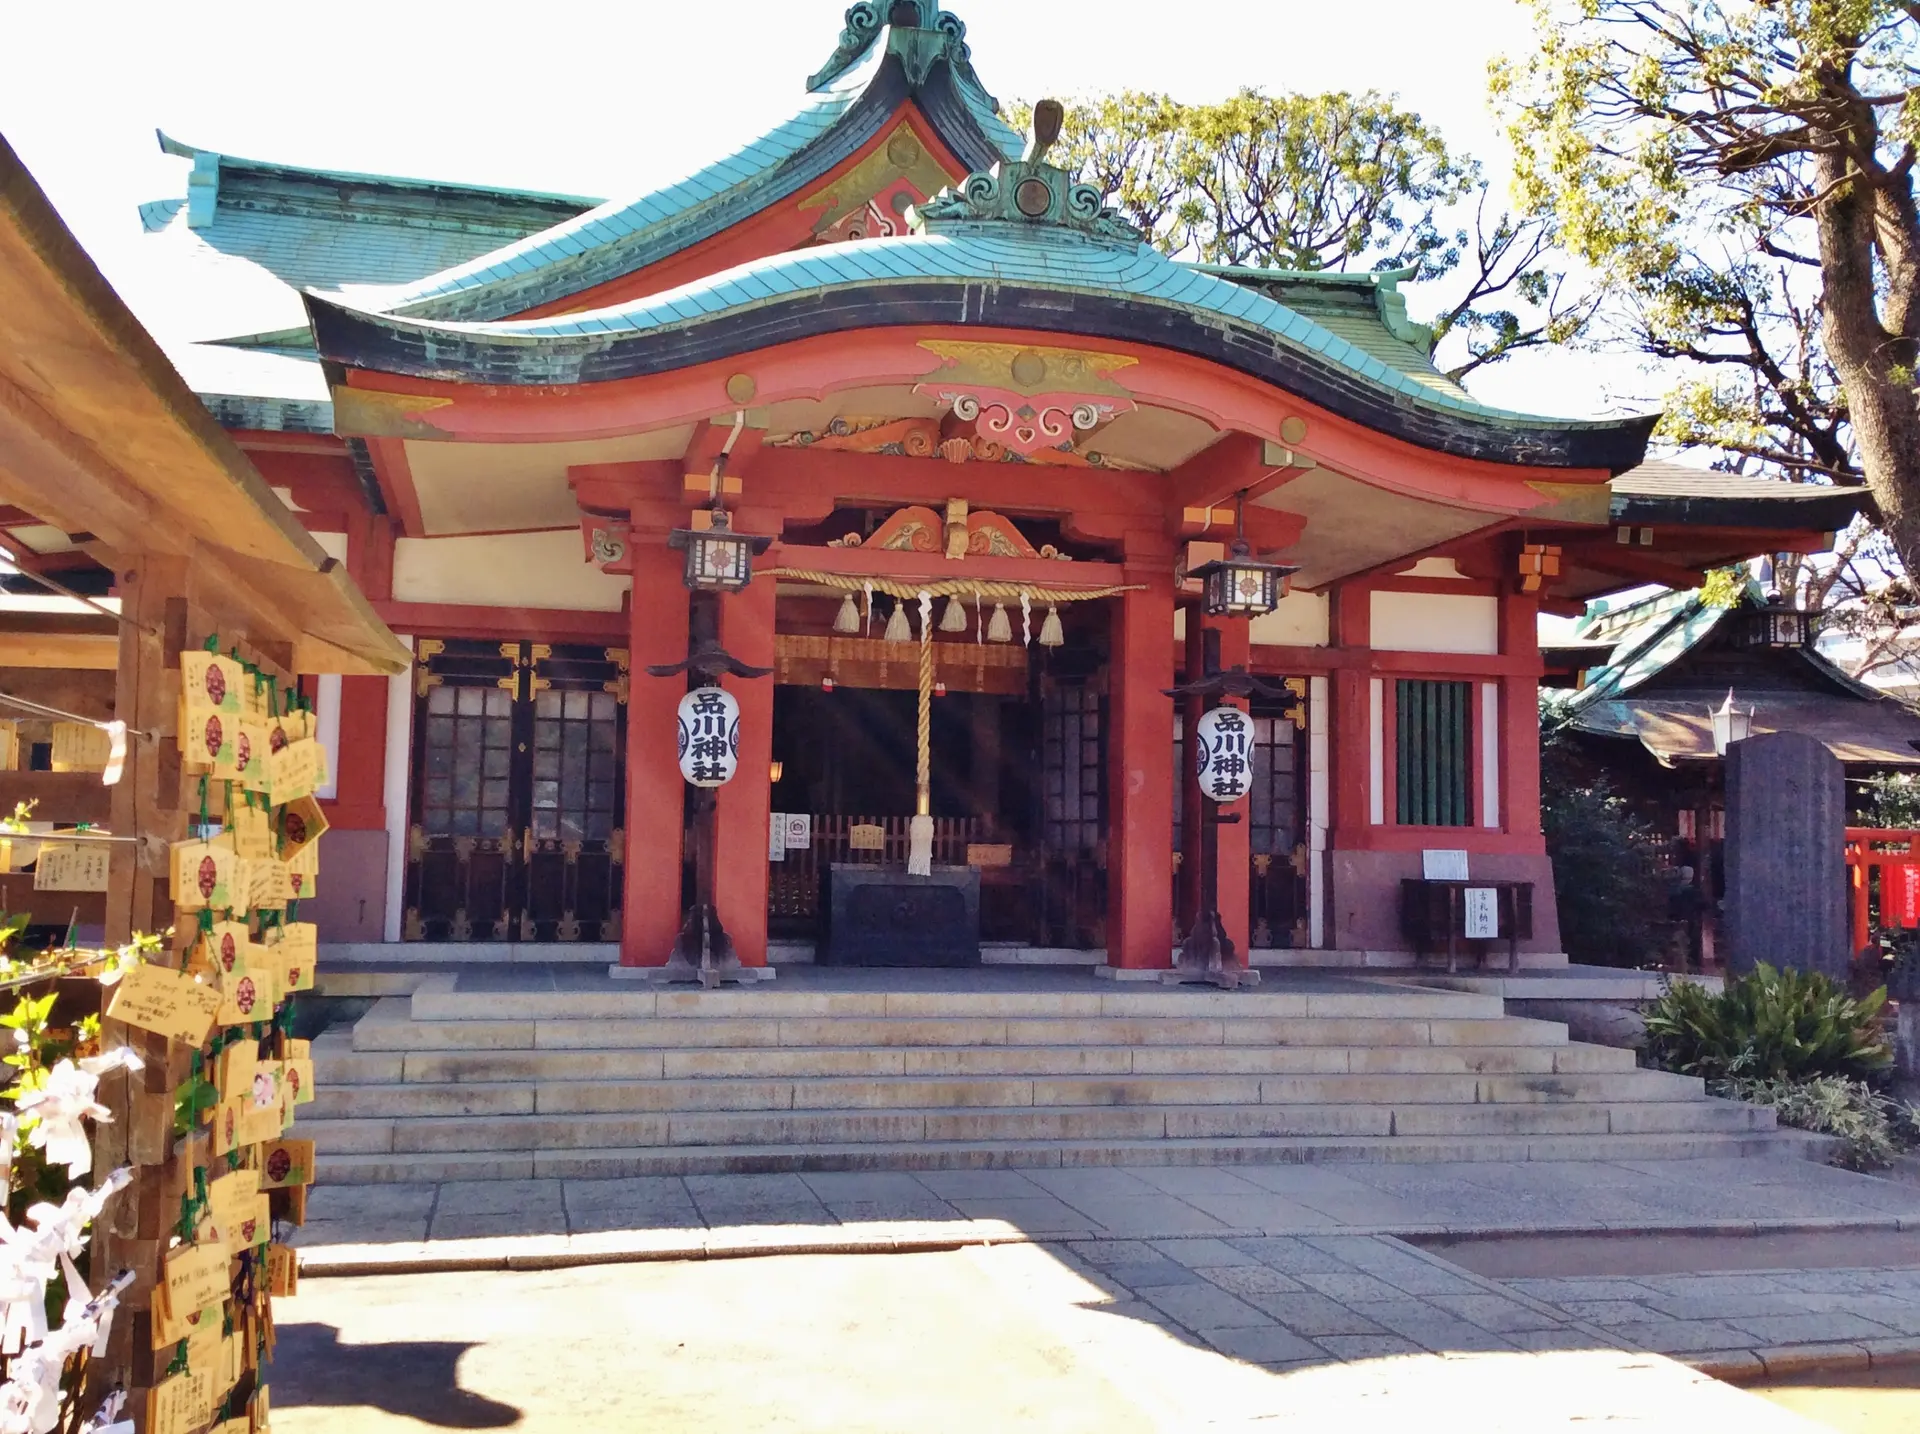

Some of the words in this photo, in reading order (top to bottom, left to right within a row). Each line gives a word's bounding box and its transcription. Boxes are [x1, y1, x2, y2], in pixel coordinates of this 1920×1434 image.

[691, 692, 728, 781] 品川神社
[1212, 713, 1246, 796] 品川神社
